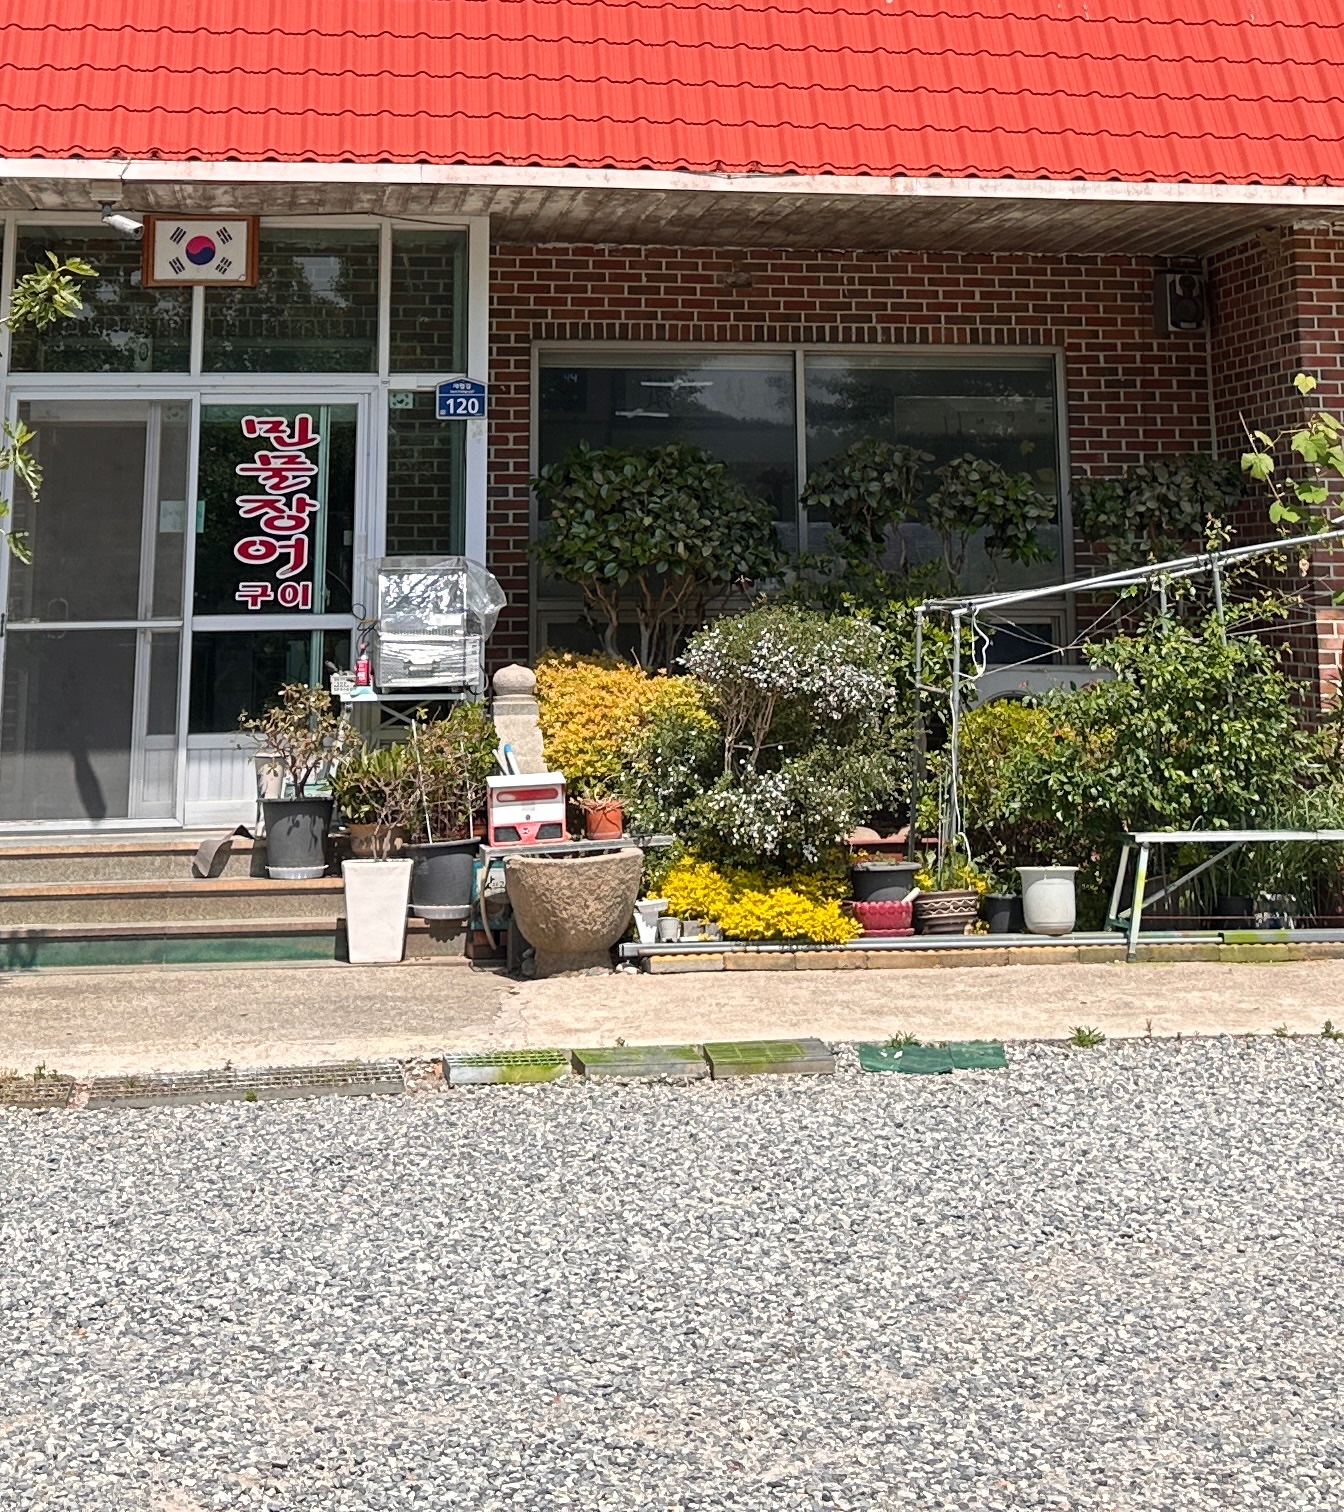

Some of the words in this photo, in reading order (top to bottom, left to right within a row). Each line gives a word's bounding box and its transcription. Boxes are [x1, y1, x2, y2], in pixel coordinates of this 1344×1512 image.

[446, 398, 479, 414] 120
[234, 413, 321, 579] 민물장어
[235, 581, 312, 610] 구이
